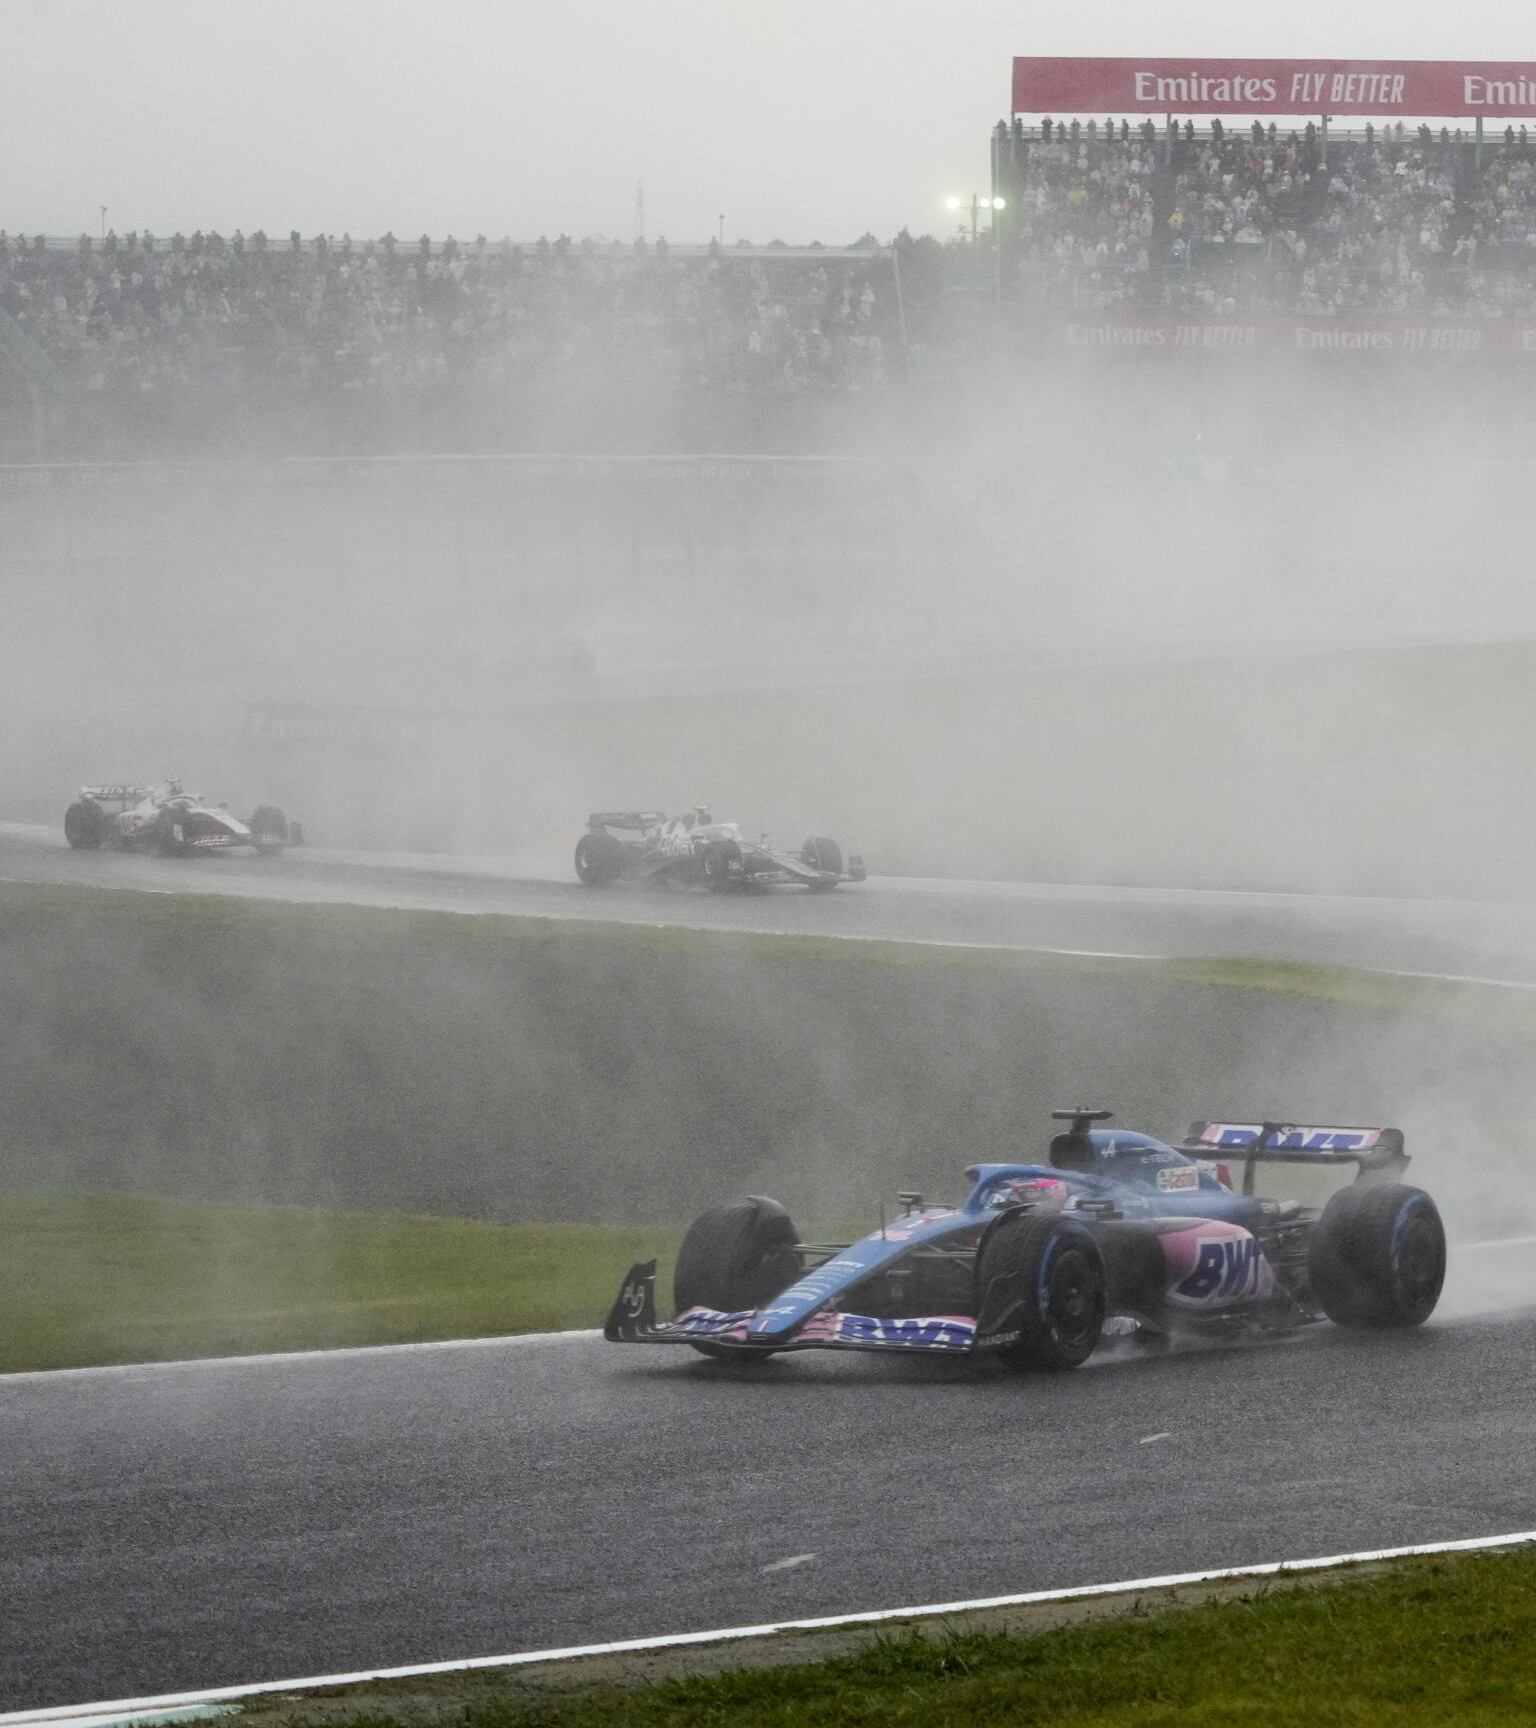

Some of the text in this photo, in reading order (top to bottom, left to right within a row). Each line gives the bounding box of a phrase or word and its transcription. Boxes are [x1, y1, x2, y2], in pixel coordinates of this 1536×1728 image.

[1134, 72, 1405, 103] Emirates FLY BETTER
[1297, 327, 1393, 349] Emirates
[1218, 1130, 1365, 1148] BWT
[1176, 1237, 1262, 1298] BWT
[840, 1315, 975, 1348] BWT
